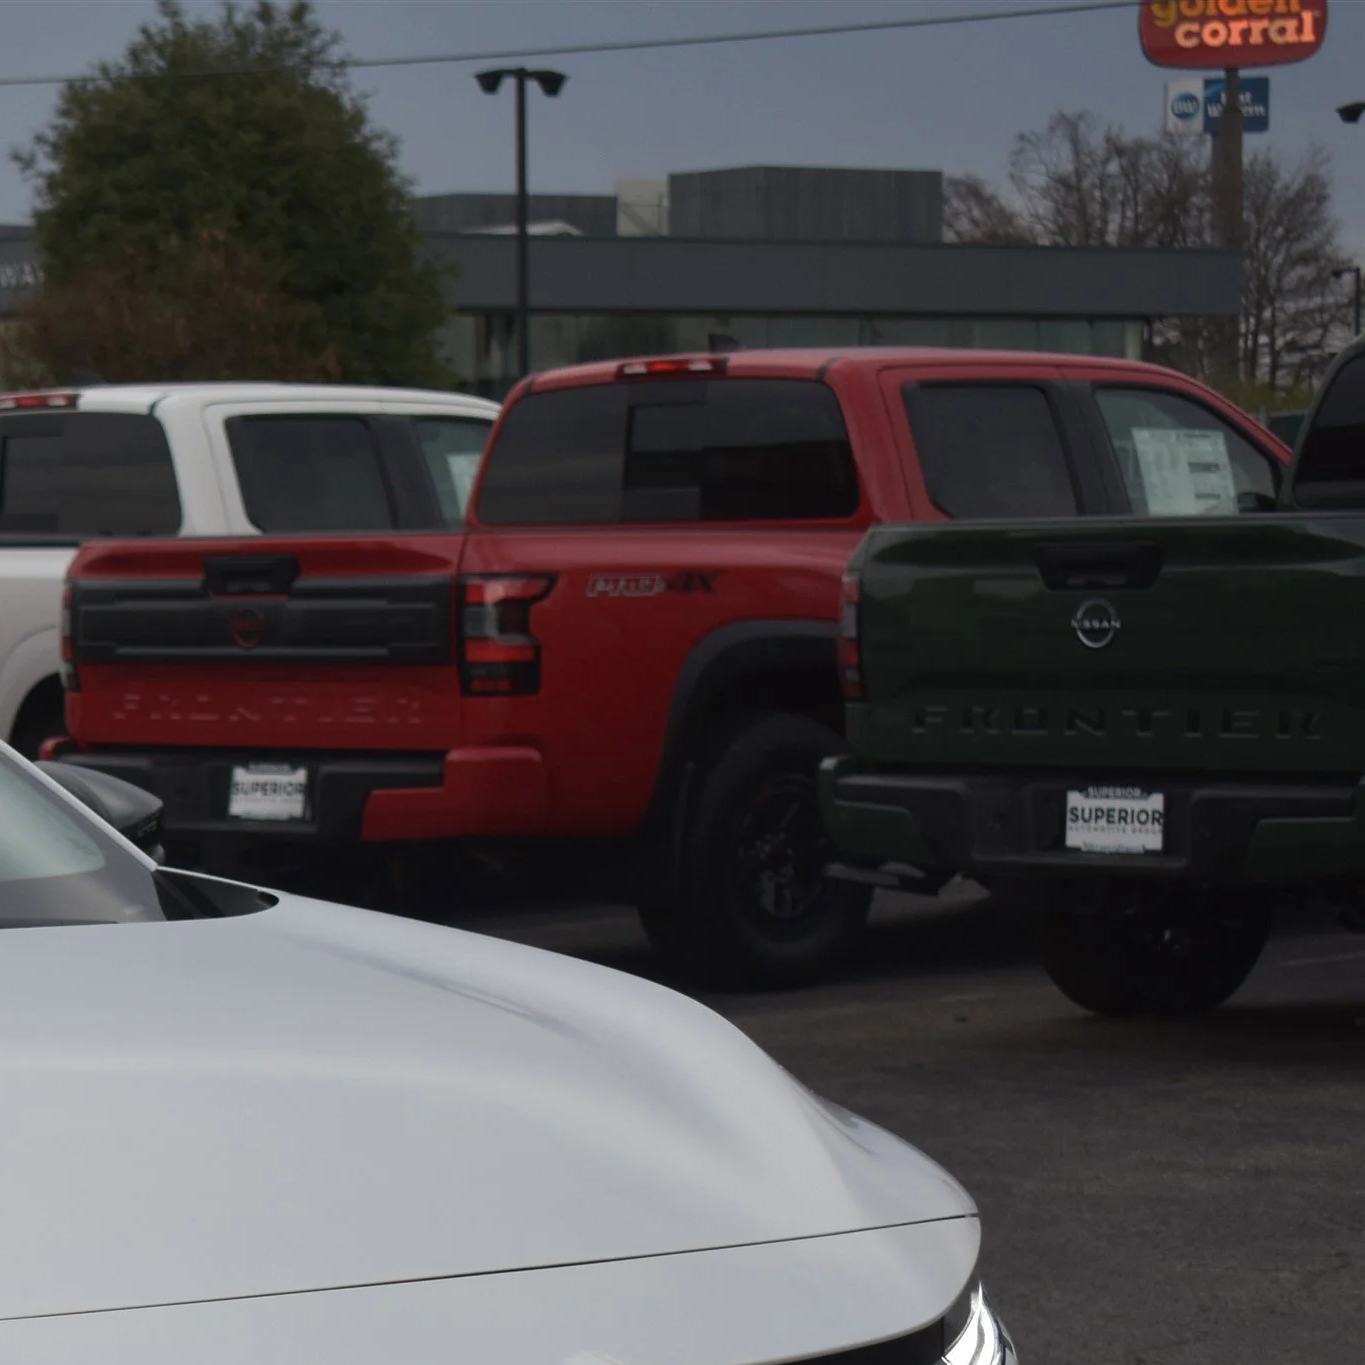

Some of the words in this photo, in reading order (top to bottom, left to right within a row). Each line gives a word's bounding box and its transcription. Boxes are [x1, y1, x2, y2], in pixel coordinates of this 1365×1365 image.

[1174, 10, 1316, 48] corral
[1071, 618, 1121, 629] NISSAN
[910, 704, 1322, 740] FRONTIER
[231, 780, 306, 796] SUPERIOR
[1087, 786, 1141, 797] SUPERIOR
[1069, 806, 1163, 826] SUPERIOR
